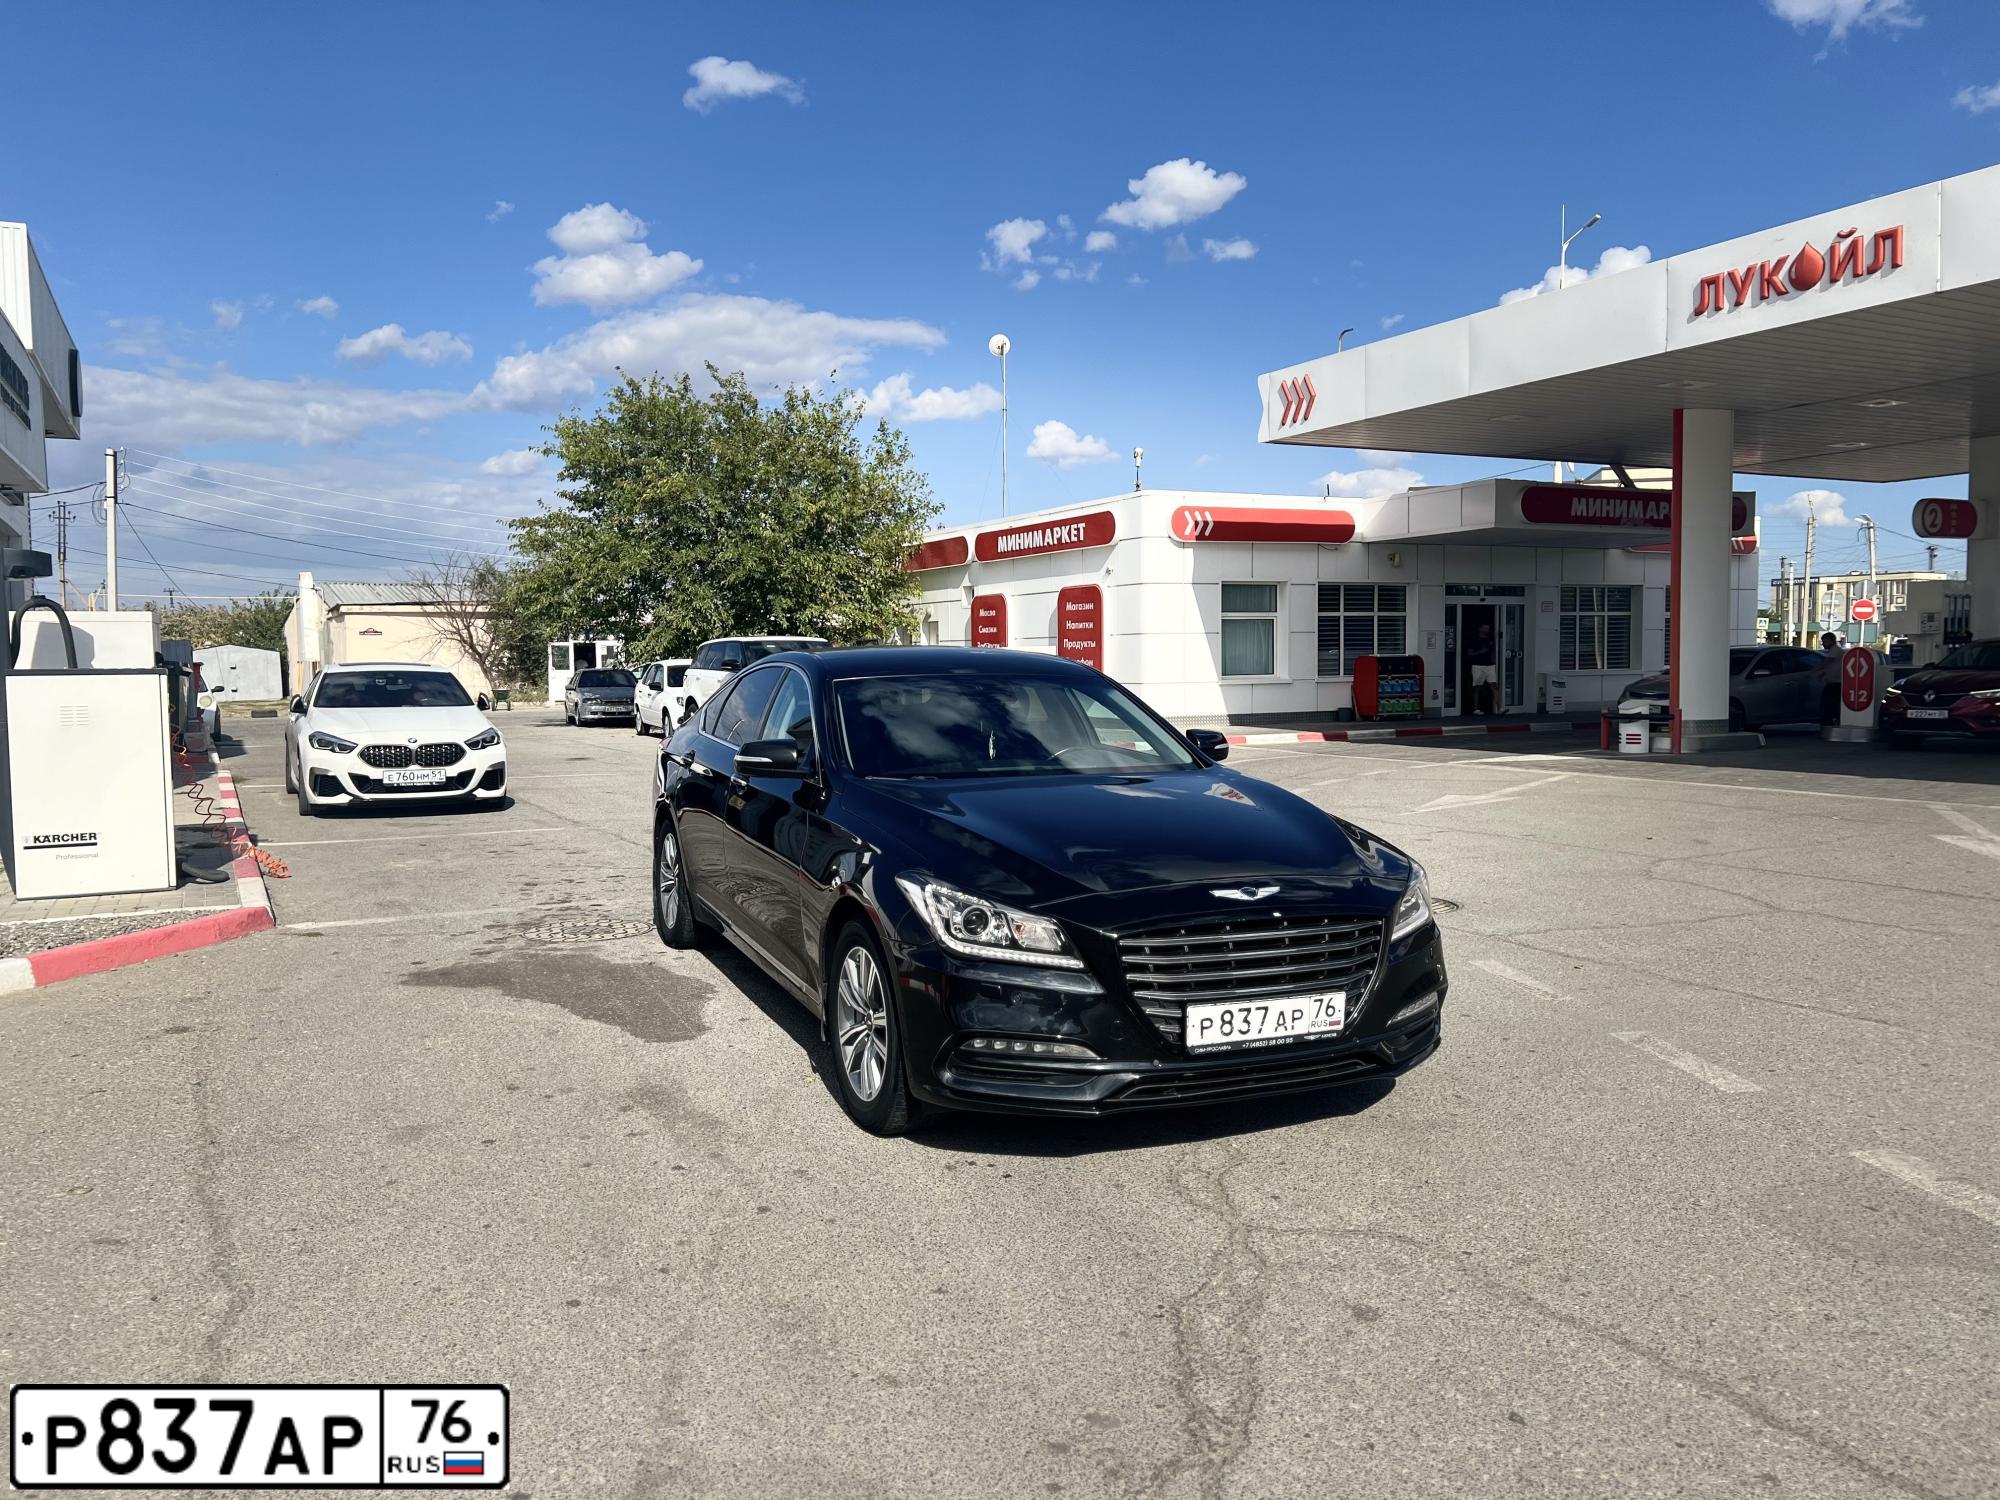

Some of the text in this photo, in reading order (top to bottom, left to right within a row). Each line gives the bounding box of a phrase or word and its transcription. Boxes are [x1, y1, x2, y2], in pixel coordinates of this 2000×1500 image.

[1695, 225, 1904, 316] ЛУКОЙЛ
[1929, 508, 1938, 528] 2
[997, 522, 1086, 553] МИНИМАРКЕТ
[1066, 602, 1094, 612] Магазин
[1066, 620, 1094, 630] Напитки
[1063, 639, 1096, 650] Продукты
[1849, 690, 1867, 701] 1 2
[33, 832, 98, 844] KÄRCHER
[55, 852, 99, 861] Professional
[1313, 998, 1336, 1019] 76
[1311, 1019, 1328, 1028] RUS
